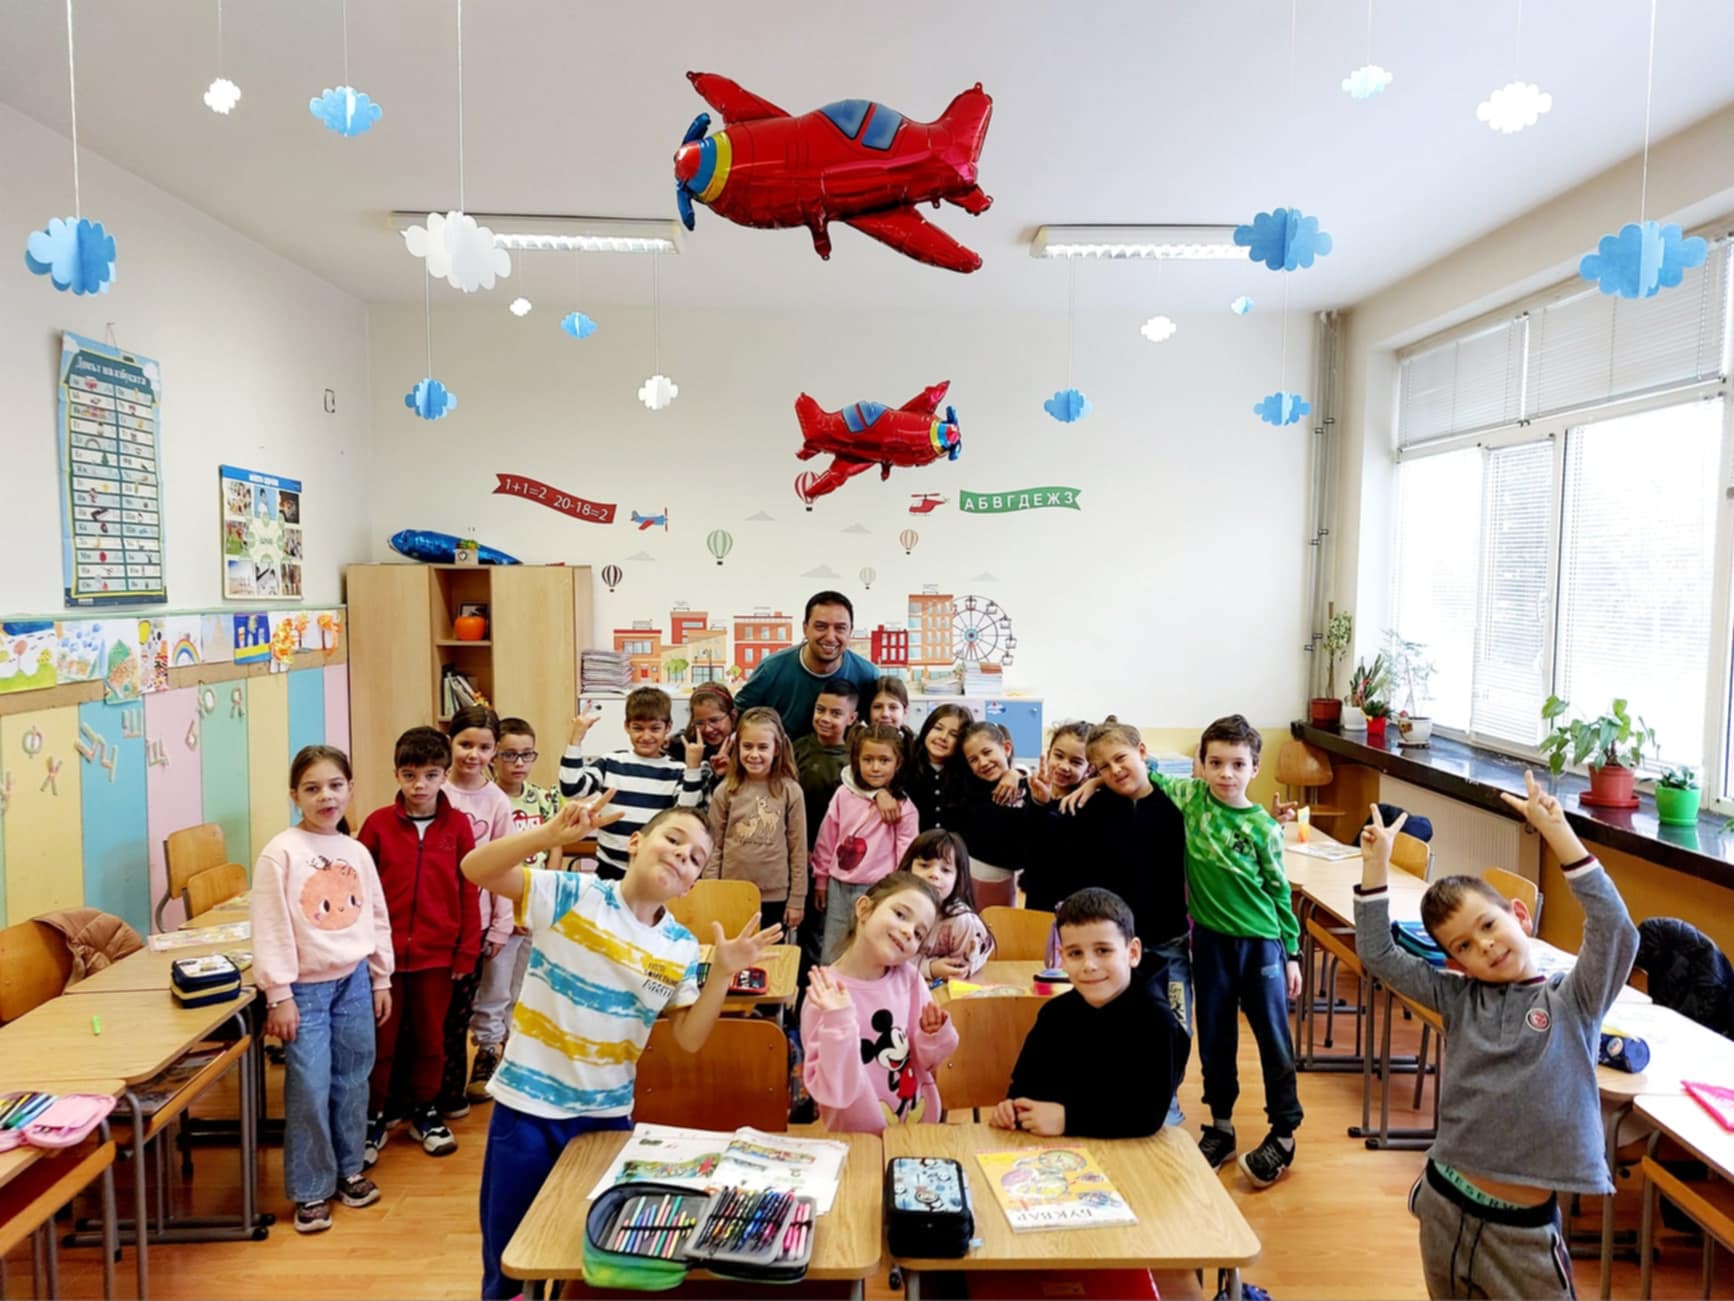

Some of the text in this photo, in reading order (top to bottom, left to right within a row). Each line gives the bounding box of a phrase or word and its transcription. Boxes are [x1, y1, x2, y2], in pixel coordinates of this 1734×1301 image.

[505, 479, 608, 521] 1+1=2 20-18=2
[1445, 1165, 1521, 1210] RESERV
